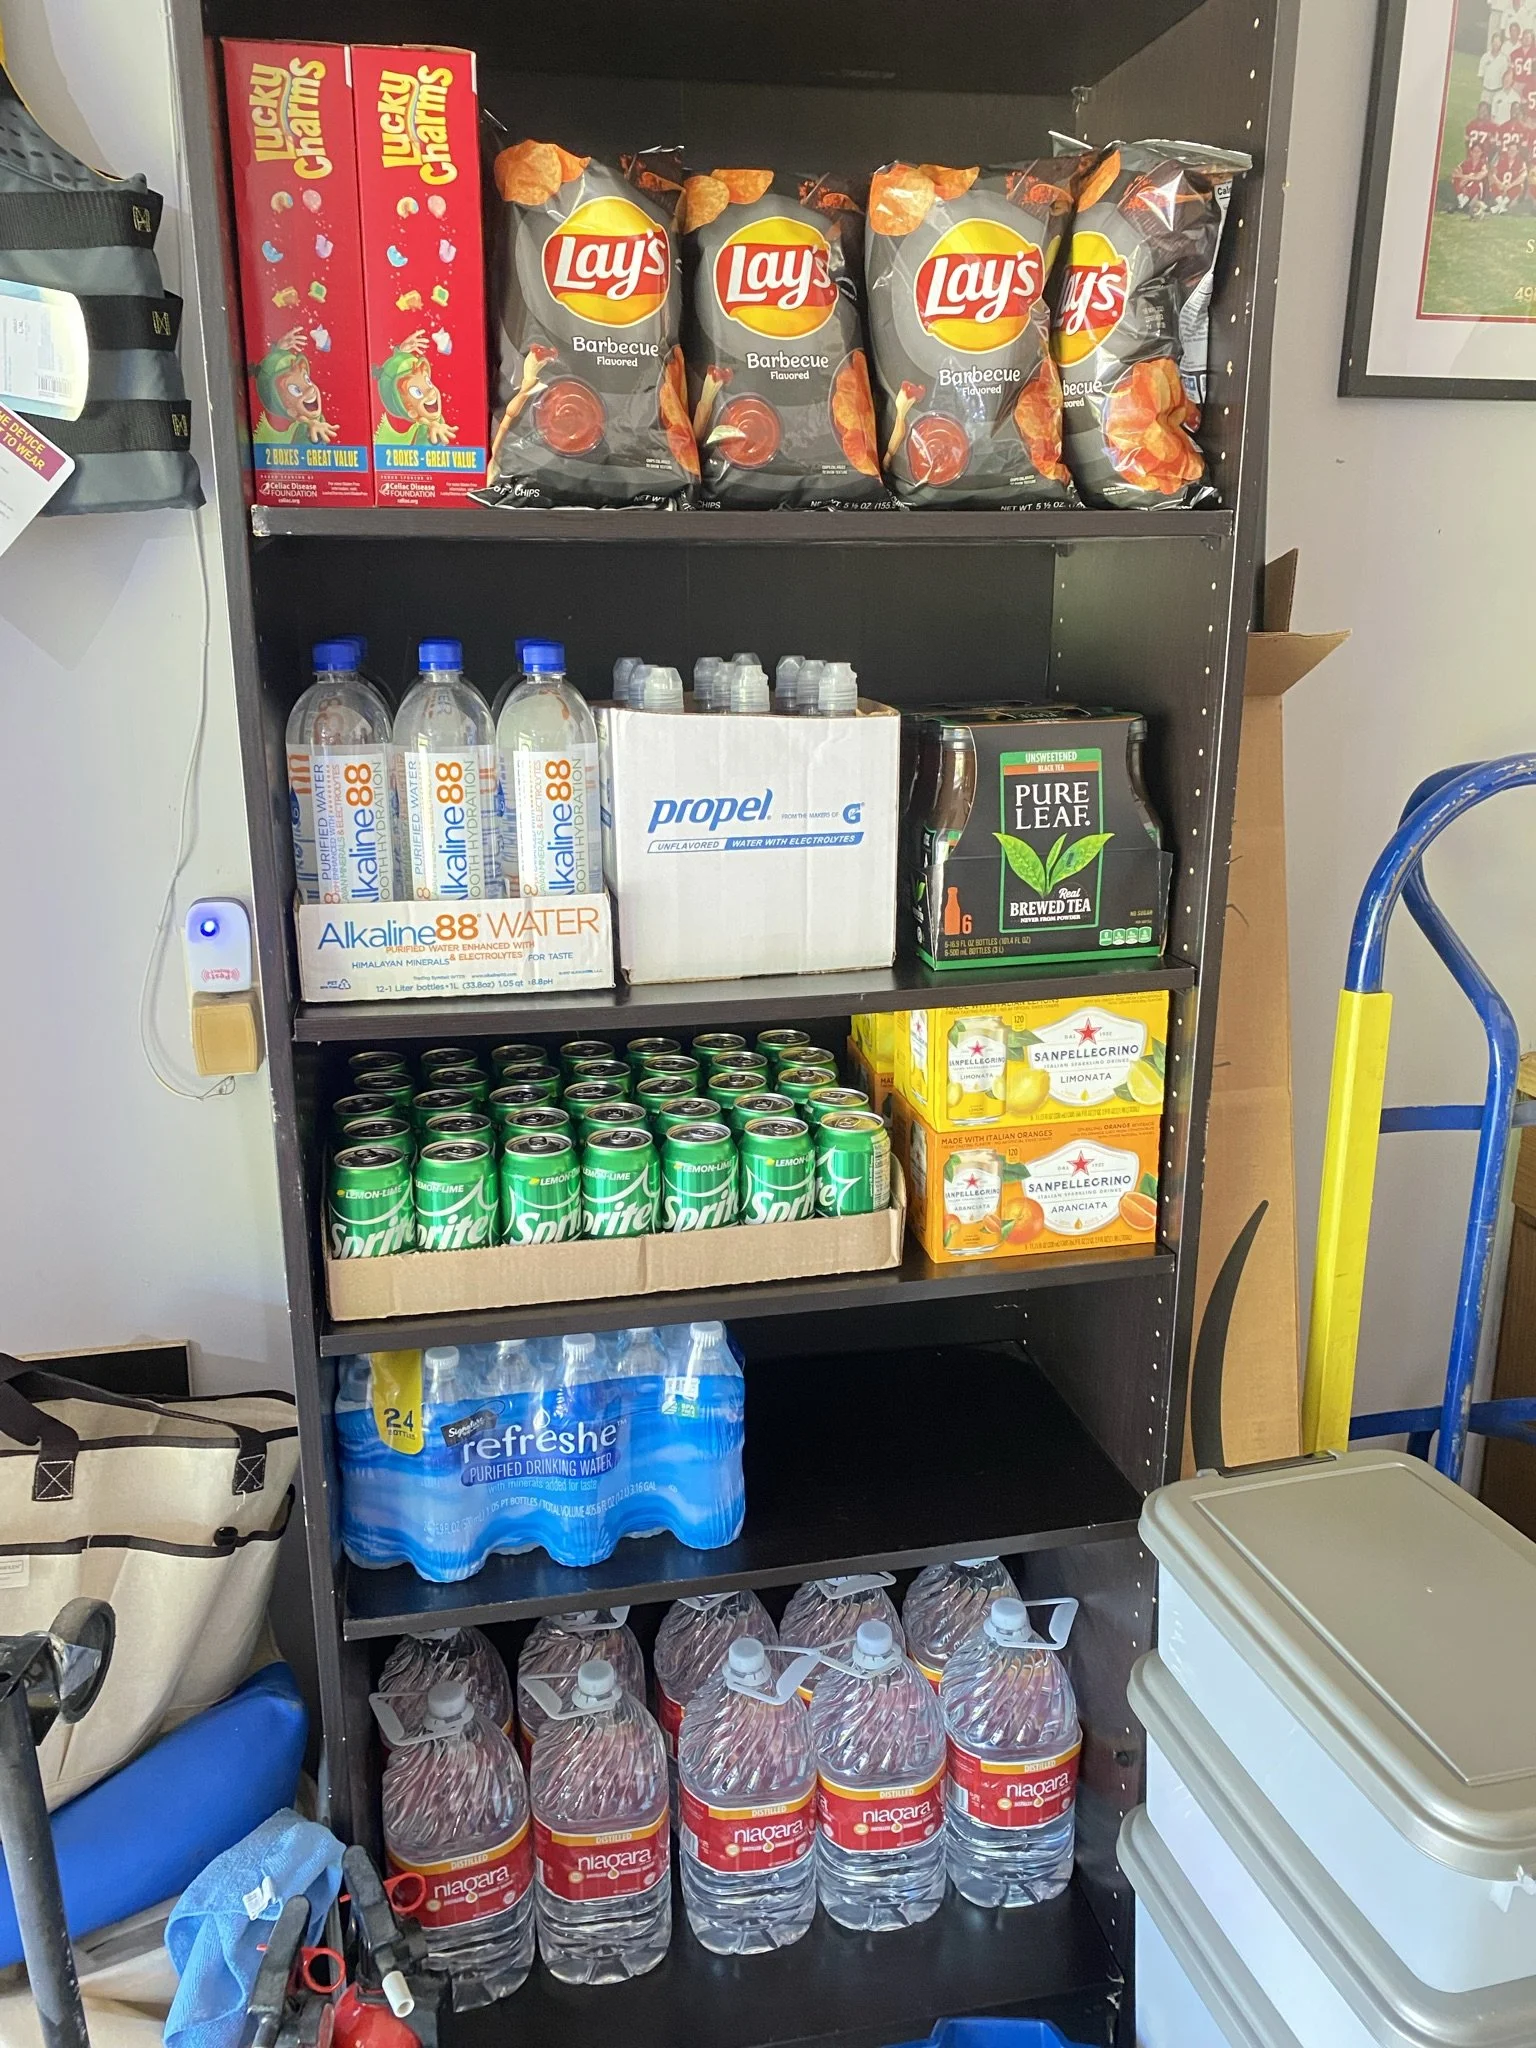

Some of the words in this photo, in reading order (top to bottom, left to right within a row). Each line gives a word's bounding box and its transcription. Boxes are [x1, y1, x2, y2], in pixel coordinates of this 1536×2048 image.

[1514, 57, 1532, 75] 64
[249, 63, 297, 161] Lucky
[288, 57, 333, 179] Charms
[378, 70, 420, 169] Lucky
[416, 65, 458, 186] Charms
[553, 228, 666, 301] Lay's
[726, 244, 831, 310] Lay's
[925, 250, 1041, 324] Lay's
[572, 336, 659, 357] Barbecue
[596, 356, 638, 368] Flavored
[747, 352, 829, 369] Barbecue
[770, 370, 810, 380] Flavored
[939, 365, 1021, 387] Barbecue
[962, 385, 1002, 396] Flavored
[9, 422, 46, 454] DEVICE
[3, 432, 17, 446] TO
[16, 443, 45, 470] WEAR
[266, 449, 271, 465] 2
[273, 448, 299, 466] BOXES
[306, 449, 333, 467] GREAT
[334, 449, 359, 468] VALUE
[386, 448, 392, 466] 2
[393, 448, 419, 467] BOXES
[425, 449, 451, 468] GREAT
[452, 449, 477, 469] VALUE
[270, 482, 290, 490] Celiac
[391, 490, 435, 498] FOUNDATION
[410, 483, 435, 491] Disease
[1036, 502, 1042, 510] 5
[1025, 751, 1078, 763] UNSWEETENED
[314, 764, 326, 813] WATER
[408, 760, 419, 809] WATER
[572, 758, 585, 847] HYDRATION
[1016, 782, 1089, 806] PURE
[373, 762, 389, 853] HYDRATION
[464, 760, 479, 849] HYDRATION
[647, 788, 773, 834] propel
[317, 817, 331, 880] PURIFIED
[411, 814, 423, 875] PURIFIED
[658, 841, 719, 851] UNFLAVORED
[732, 837, 763, 847] WATER
[765, 837, 788, 846] WITH
[789, 835, 855, 846] ELECTROLYTES
[1058, 888, 1081, 900] Real
[1010, 900, 1065, 917] BREWED
[1067, 898, 1091, 913] TEA
[962, 914, 973, 934] 6
[1057, 914, 1081, 922] POWDER
[318, 914, 479, 950] Alkaline88
[486, 908, 599, 938] WATER
[386, 945, 425, 953] PURIFIED
[428, 944, 459, 952] WATER
[462, 942, 510, 951] ENHANCED
[512, 941, 535, 949] WITH
[968, 947, 991, 955] BOTTLES
[975, 939, 998, 947] BOTTLES
[352, 960, 403, 968] HIMALAYAN
[406, 959, 450, 967] MINERALS
[459, 951, 523, 960] ELECTROLYTES
[549, 952, 573, 960] TASTE
[395, 984, 413, 992] Liter
[416, 983, 444, 991] bottles
[462, 981, 495, 990] (33.8oz)
[1014, 1015, 1024, 1024] 120
[1034, 1044, 1139, 1062] SANPELLEGRINO
[1060, 1073, 1111, 1083] LIMONATA
[965, 1136, 985, 1144] WITH
[986, 1133, 1016, 1141] ITALIAN
[1017, 1130, 1052, 1139] ORANGES
[345, 1184, 402, 1199] LEMON-LIME
[415, 1179, 465, 1193] LEMON-LIME
[1029, 1175, 1131, 1193] SANPELLEGRINO
[1051, 1202, 1108, 1213] ARANCIATA
[383, 1408, 414, 1431] 24
[463, 1422, 617, 1464] refreshe
[470, 1461, 522, 1481] PURIFIED
[526, 1460, 576, 1477] DRINKING
[580, 1453, 613, 1476] WATER
[507, 1479, 543, 1490] minerals
[545, 1479, 567, 1491] added
[569, 1480, 579, 1490] for
[580, 1480, 597, 1490] taste
[510, 1497, 538, 1507] BOTTLES
[1023, 1760, 1056, 1773] DISTILLED
[880, 1789, 915, 1799] DISTILLED
[1007, 1772, 1069, 1807] niagara
[751, 1806, 787, 1818] DISTILLED
[863, 1801, 931, 1832] niagara
[596, 1833, 632, 1844] DISTILLED
[734, 1820, 803, 1852] niagara
[451, 1854, 488, 1870] DISTILLED
[578, 1848, 652, 1879] niagara
[434, 1866, 509, 1903] niagara
